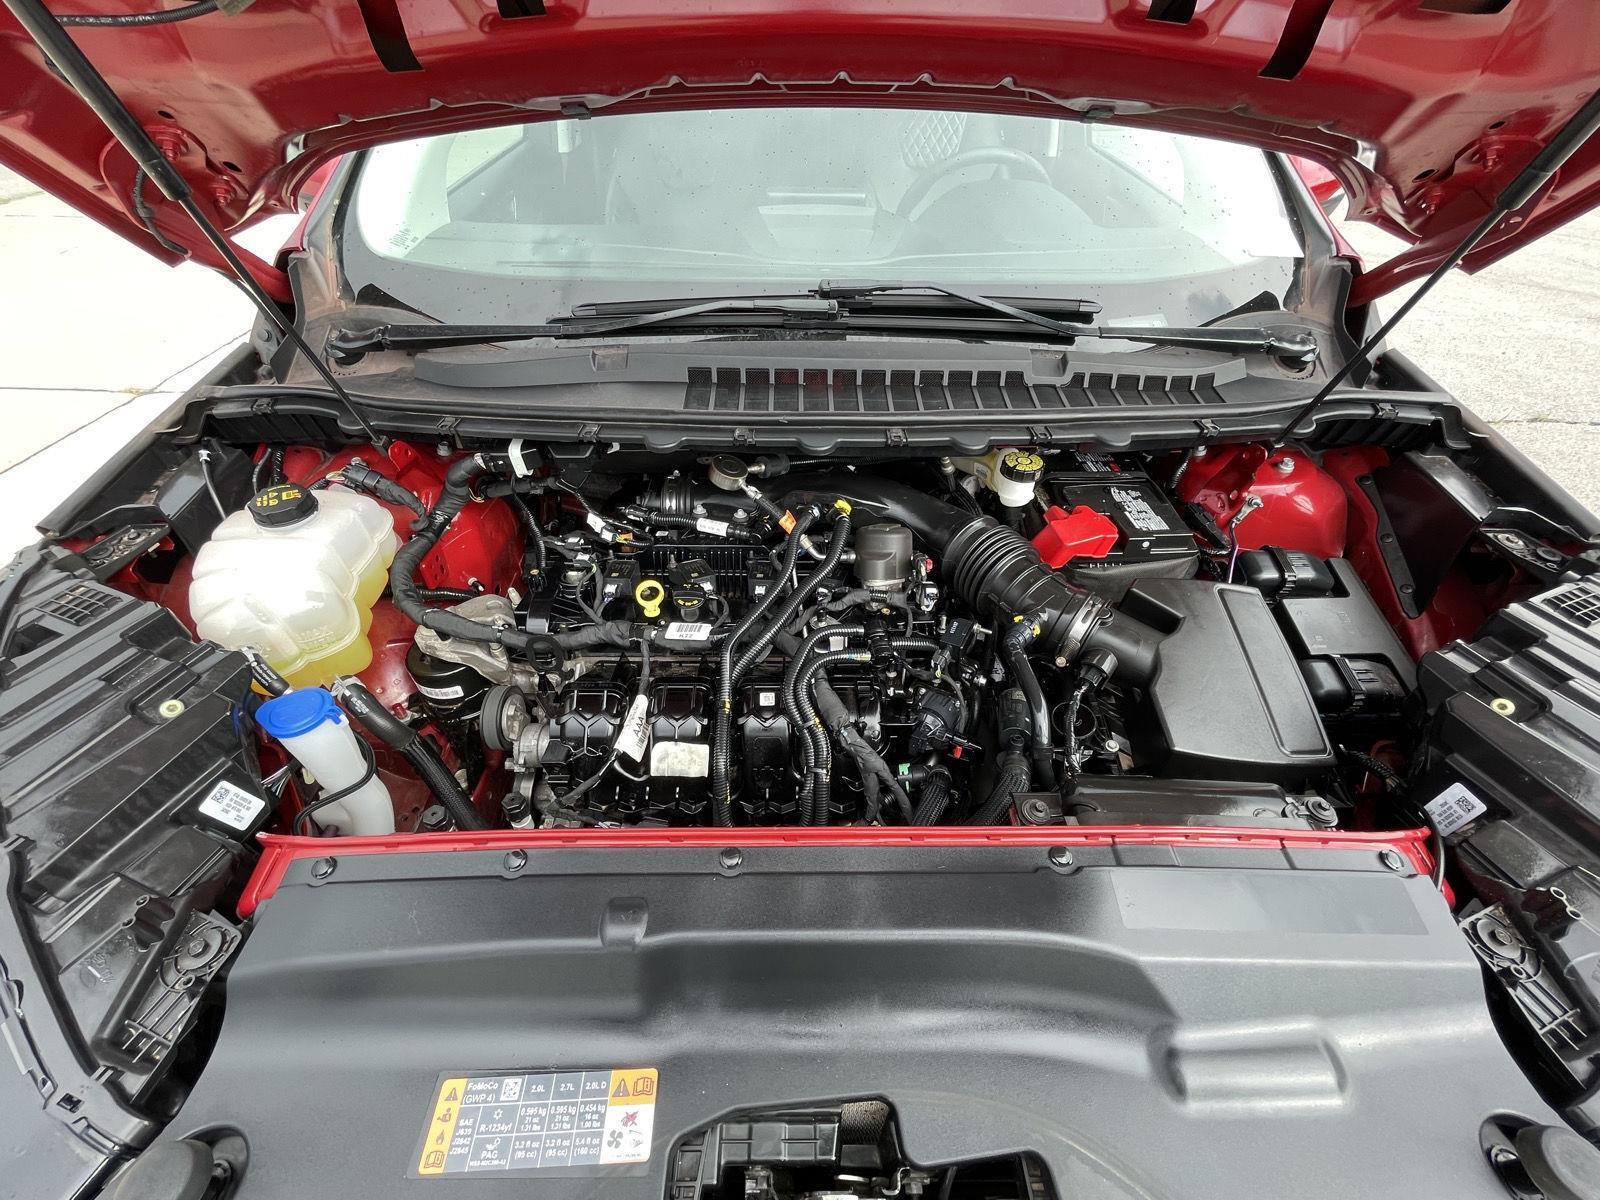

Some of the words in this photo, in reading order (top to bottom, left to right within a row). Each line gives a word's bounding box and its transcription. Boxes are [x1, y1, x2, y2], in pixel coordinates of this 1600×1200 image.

[467, 1081, 499, 1091] FoMoCo
[530, 1085, 545, 1093] 2.0L
[560, 1083, 575, 1091] 2.7L
[585, 1082, 600, 1090] 2.0L
[601, 1081, 607, 1089] D
[462, 1095, 486, 1105] (GWP
[486, 1093, 496, 1104] 4)
[538, 1106, 547, 1117] kg
[568, 1104, 577, 1115] kg
[580, 1103, 597, 1113] 0.454
[597, 1102, 606, 1113] kg
[459, 1118, 474, 1127] SAE
[479, 1123, 512, 1134] R-1234yf
[514, 1140, 525, 1149] 3.2
[545, 1139, 556, 1147] 3.2
[481, 1150, 498, 1159] PAG
